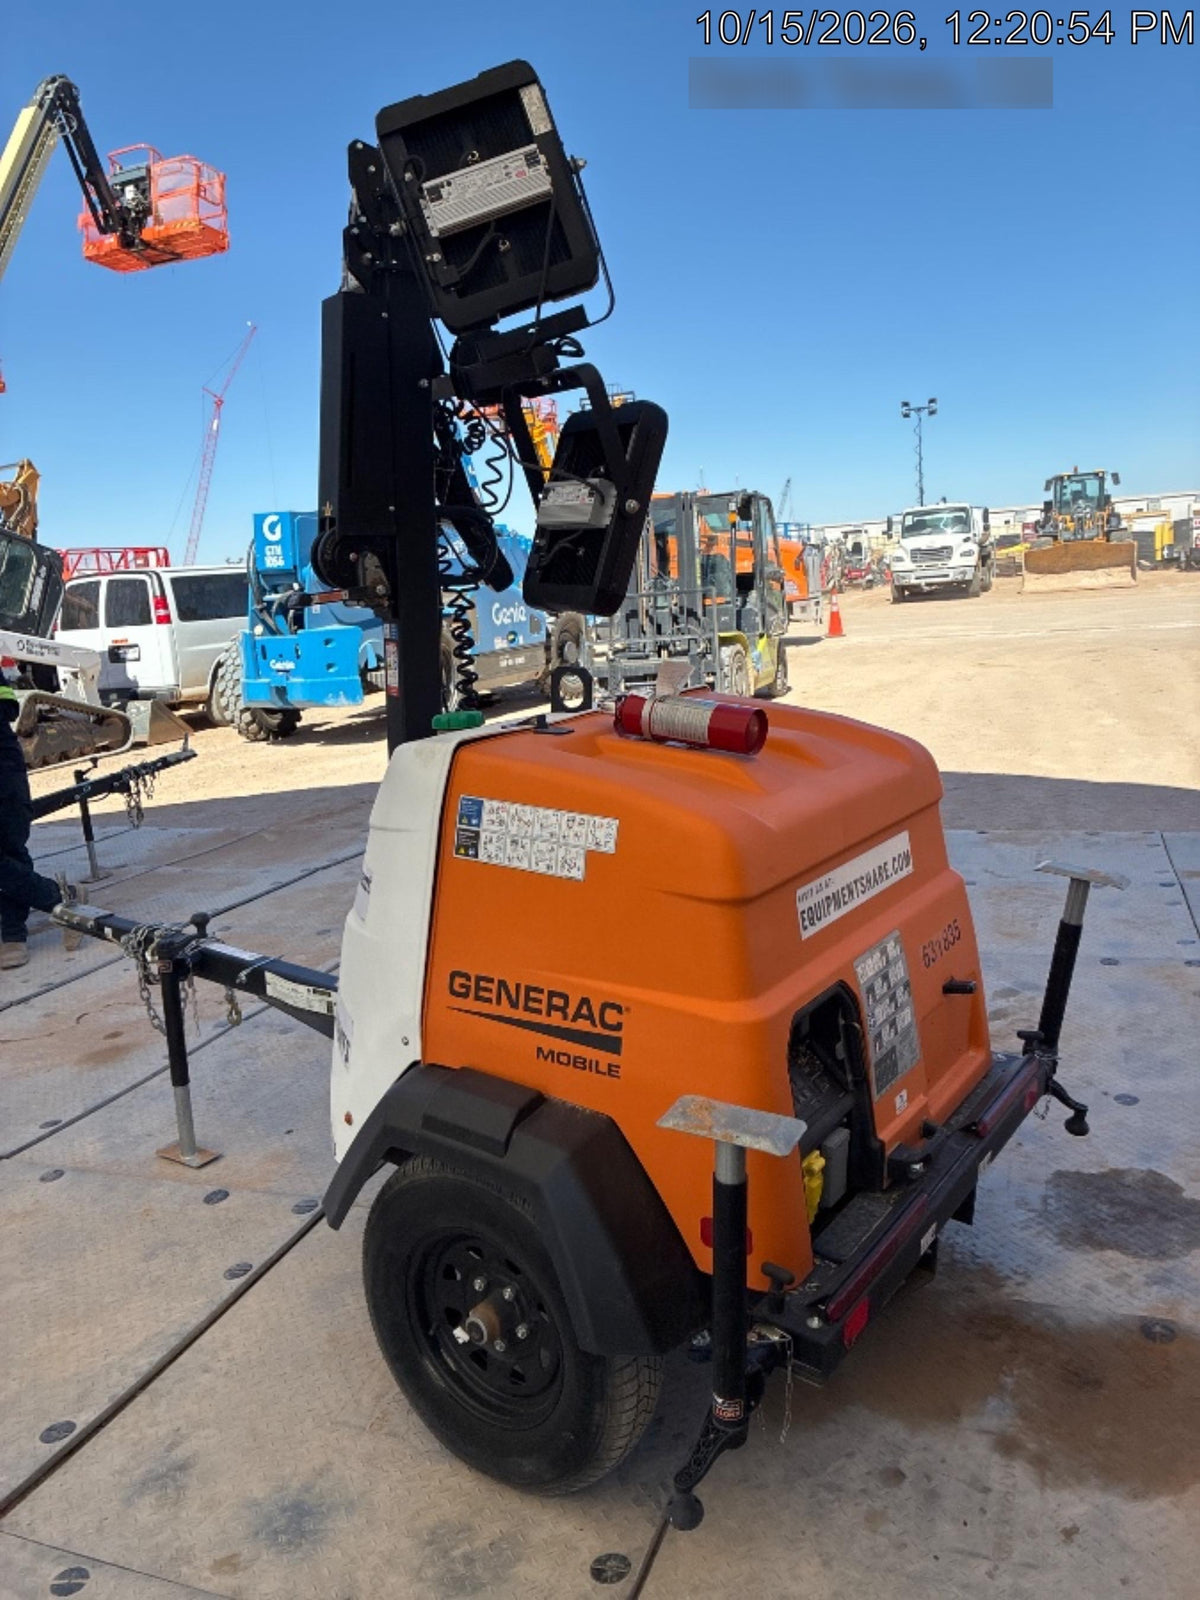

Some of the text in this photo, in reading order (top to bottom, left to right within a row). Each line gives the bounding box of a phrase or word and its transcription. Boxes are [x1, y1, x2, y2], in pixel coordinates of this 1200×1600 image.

[491, 602, 527, 626] Genie
[799, 848, 911, 931] EQUIPMENTSHARE.COM
[448, 969, 623, 1033] GENERAC
[536, 1046, 621, 1080] MOBILE
